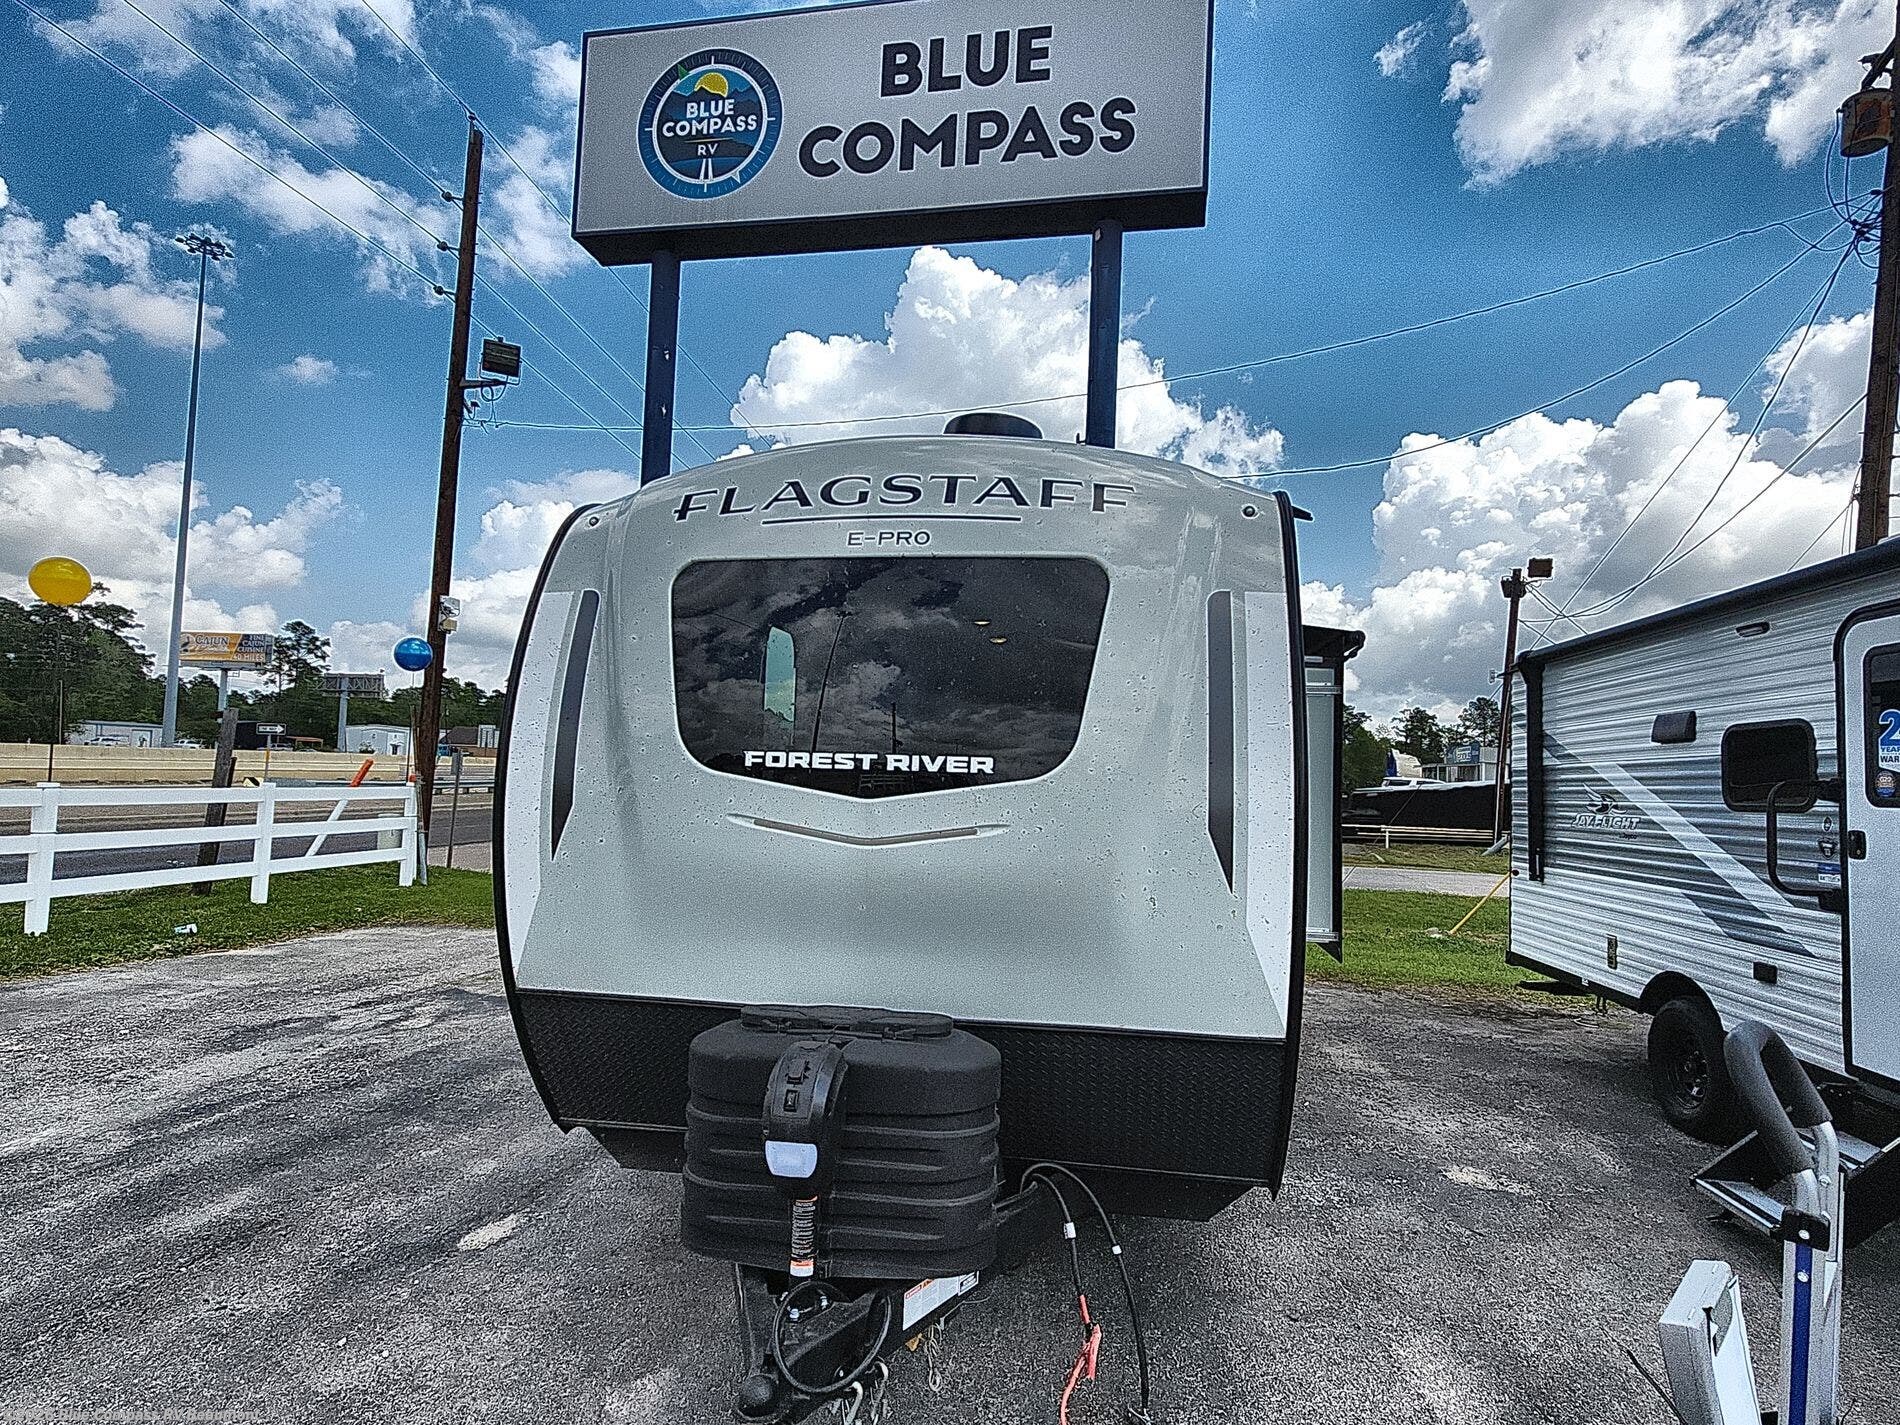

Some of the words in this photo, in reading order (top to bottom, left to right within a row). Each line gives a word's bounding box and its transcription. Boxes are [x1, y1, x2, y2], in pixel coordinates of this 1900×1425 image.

[880, 25, 1053, 98] BLUE
[686, 99, 735, 119] BLUE
[662, 115, 758, 137] COMPASS
[798, 97, 1137, 178] COMPASS
[697, 143, 719, 156] RV
[672, 475, 1136, 522] FLAGSTAFF
[846, 530, 931, 546] E-PRO
[743, 751, 878, 770] FOREST
[886, 754, 994, 774] RIVER
[1572, 814, 1594, 828] JAY
[1593, 815, 1640, 829] FLIGHT
